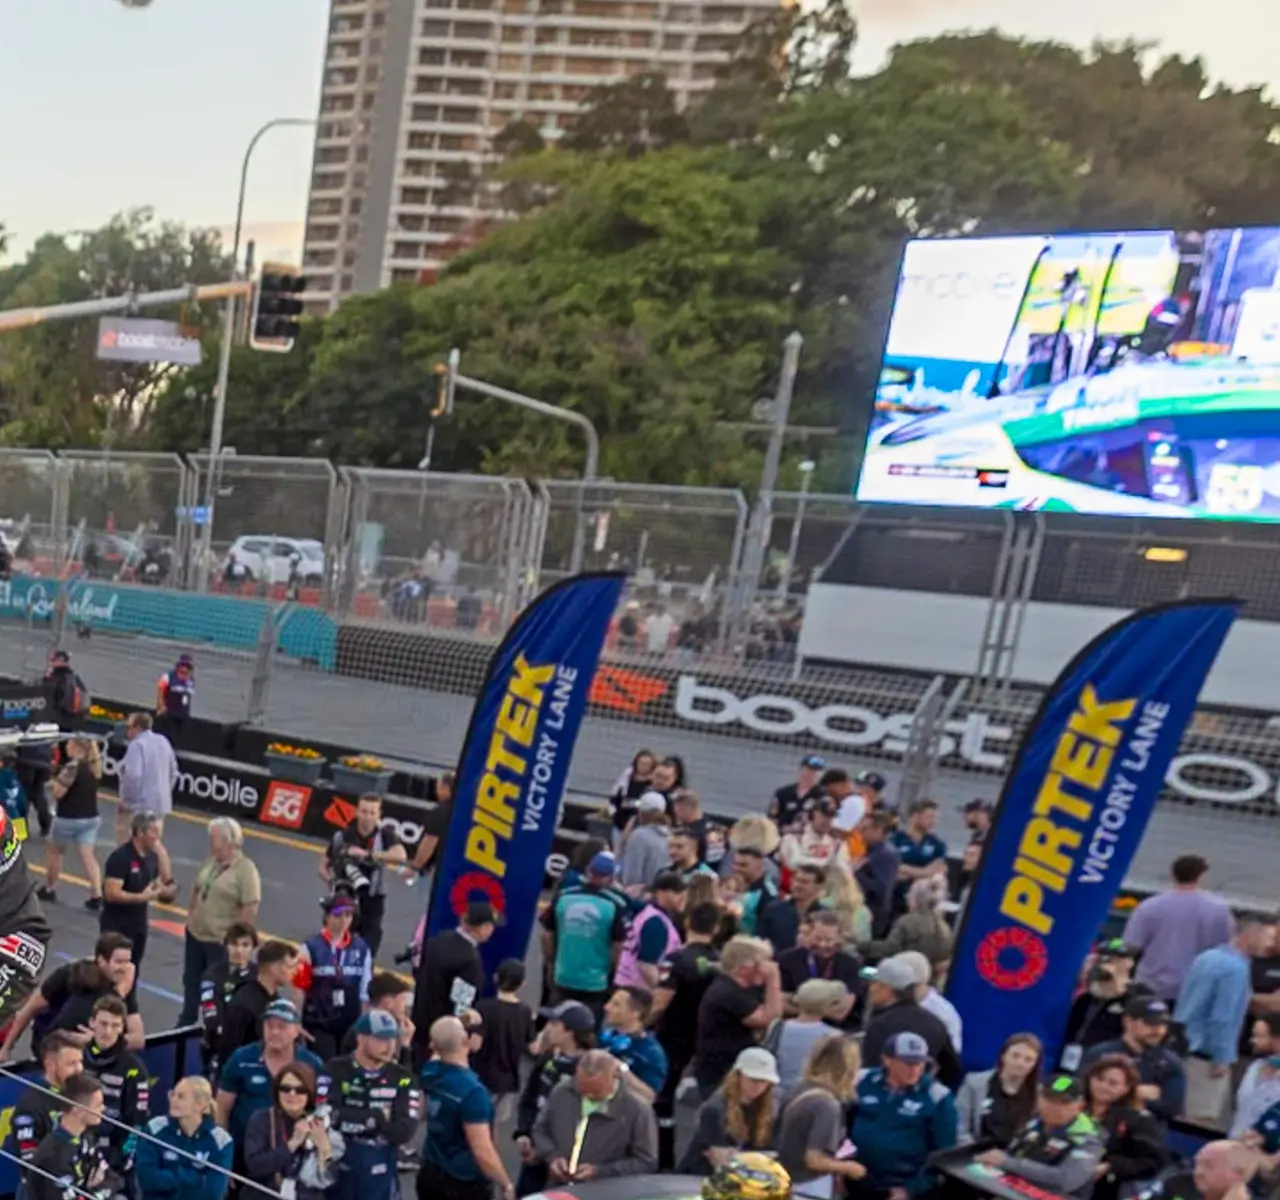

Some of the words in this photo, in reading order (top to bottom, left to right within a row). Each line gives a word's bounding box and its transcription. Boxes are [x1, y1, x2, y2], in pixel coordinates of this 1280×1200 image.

[177, 773, 258, 808] mobile
[464, 652, 556, 878] PIRTEK
[521, 731, 560, 833] VICTORY
[546, 664, 578, 731] LANE
[1000, 683, 1138, 936] PIRTEK
[1078, 773, 1138, 884] VICTORY
[1121, 700, 1171, 773] LANE
